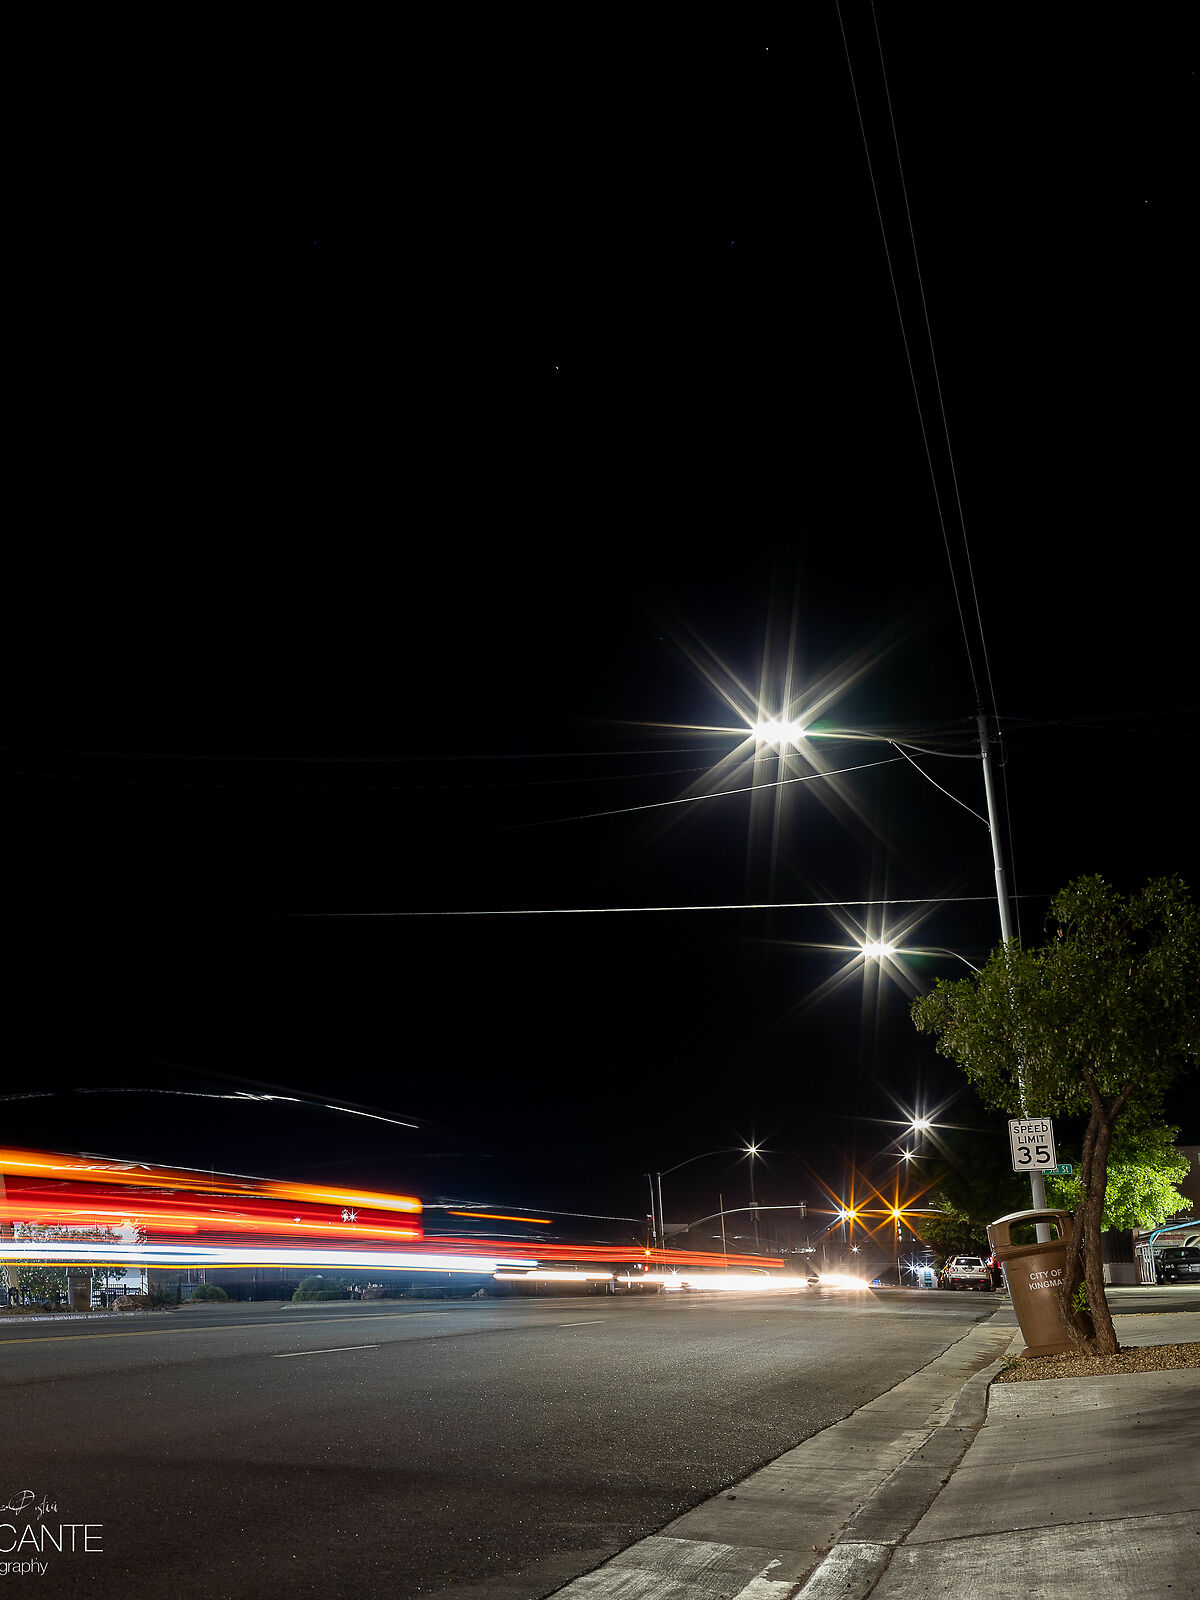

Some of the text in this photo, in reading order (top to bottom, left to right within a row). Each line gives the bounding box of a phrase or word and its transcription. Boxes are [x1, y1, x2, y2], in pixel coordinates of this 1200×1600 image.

[1013, 1124, 1049, 1134] SPEED
[1018, 1135, 1045, 1144] LIMIT
[1017, 1145, 1051, 1165] 35
[1029, 1268, 1062, 1280] CITY OF
[1028, 1278, 1065, 1291] KINGMA
